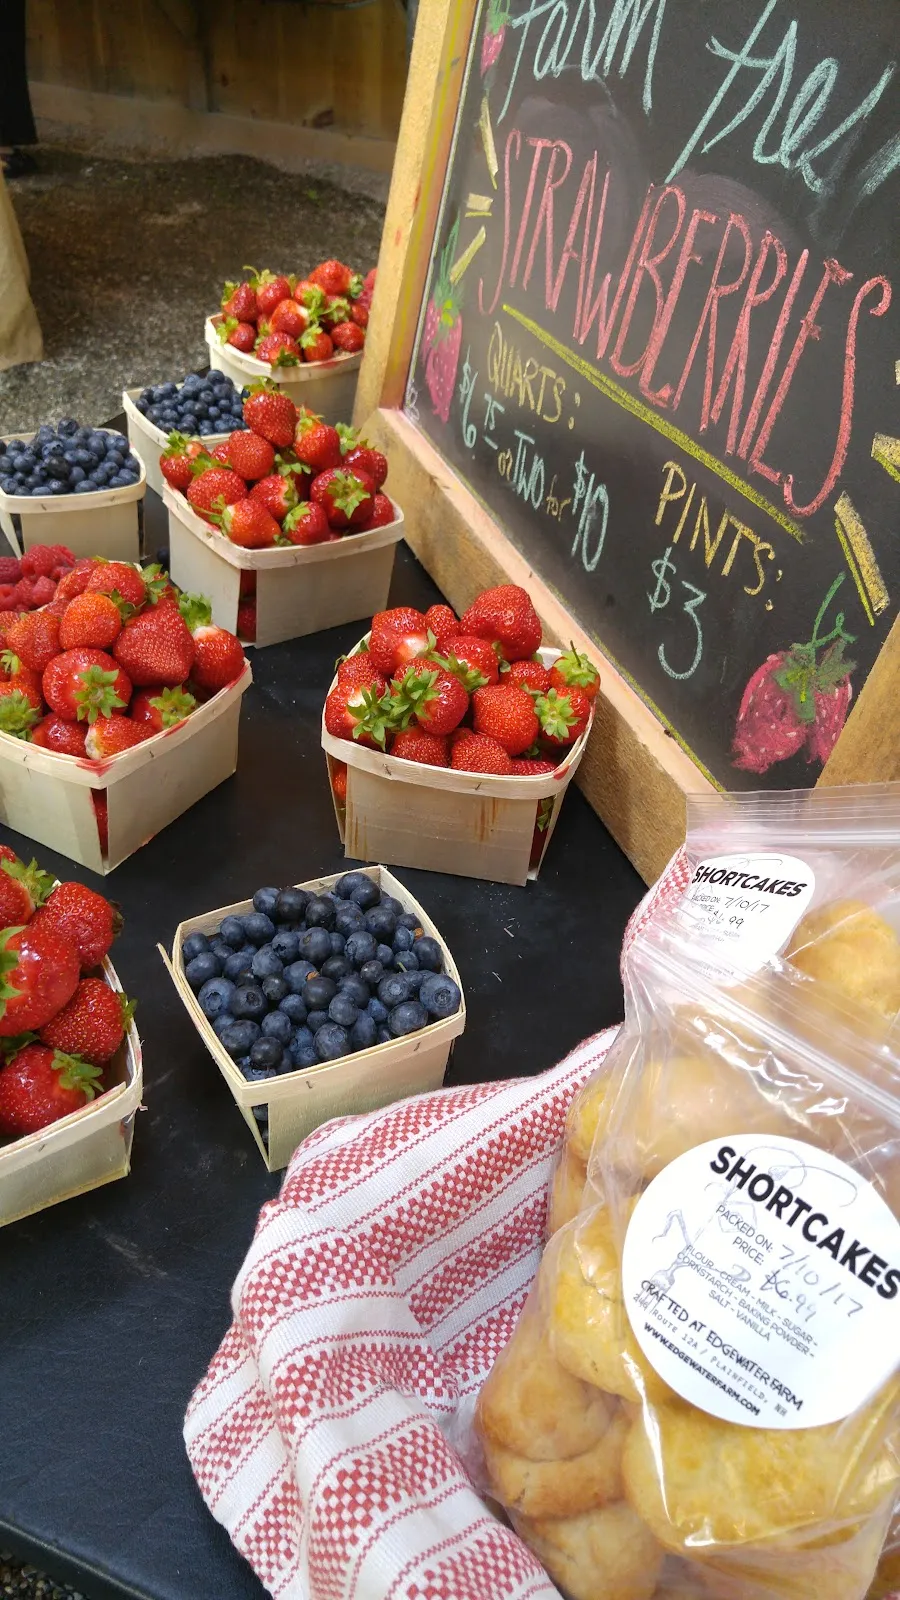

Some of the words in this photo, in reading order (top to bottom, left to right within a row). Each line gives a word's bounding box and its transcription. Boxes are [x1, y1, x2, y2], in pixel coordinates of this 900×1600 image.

[478, 129, 892, 517] STRAWBERRIES
[512, 430, 545, 510] TWO
[546, 474, 571, 521] for
[572, 450, 609, 572] $10
[647, 546, 708, 681] $3
[691, 865, 808, 897] SHORTCAKES
[725, 896, 771, 914] 7/10/17
[710, 1145, 900, 1300] SHORTCAKES
[715, 1204, 755, 1238] PACKED
[754, 1234, 774, 1253] ON:
[779, 1243, 864, 1317] 7/10/17
[732, 1236, 765, 1266] PRICE:
[640, 1280, 690, 1322] CRAFTED
[689, 1320, 707, 1333] AT
[706, 1330, 770, 1385] EDGEWATER
[769, 1378, 804, 1411] FARM
[676, 1251, 733, 1298] CORNSTARCH
[738, 1299, 770, 1326] BAKING
[770, 1323, 810, 1356] POWDER
[681, 1333, 698, 1350] 12A
[685, 1244, 714, 1269] FLOUR
[719, 1270, 751, 1298] CREAM
[756, 1297, 778, 1317] MILK
[782, 1317, 813, 1345] SUGAR
[708, 1288, 731, 1309] SALT
[735, 1309, 771, 1342] VANILLA
[643, 1322, 761, 1416] WWW.EDGEWATERFARM.COM
